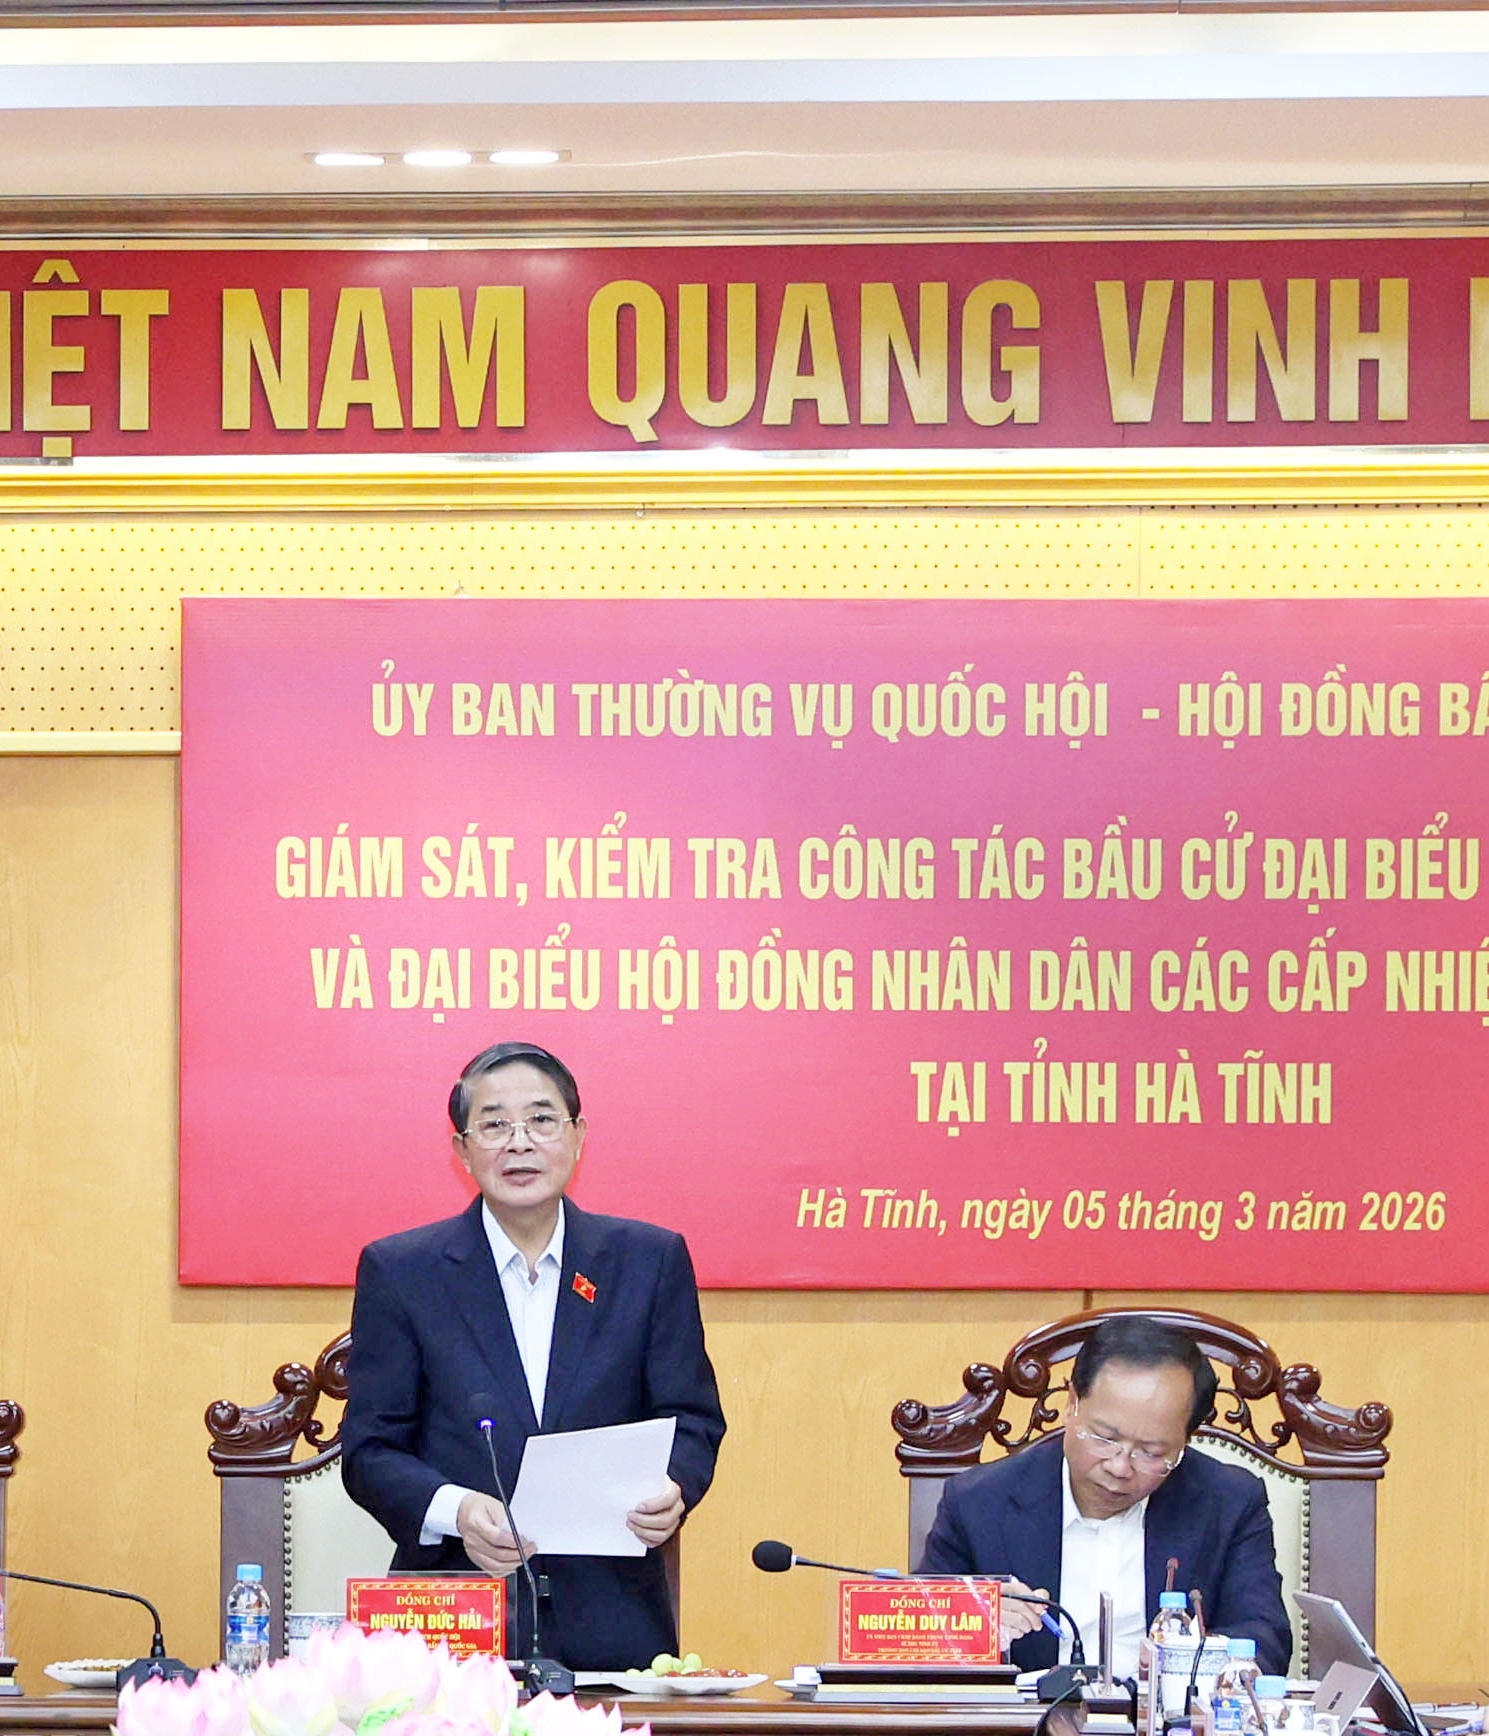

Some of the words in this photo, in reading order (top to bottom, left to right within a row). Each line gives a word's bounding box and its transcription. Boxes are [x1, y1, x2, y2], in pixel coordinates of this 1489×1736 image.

[220, 285, 526, 430] NAM
[586, 278, 1041, 443] QUANG
[1094, 277, 1410, 424] VINH
[371, 658, 435, 737] ỦY
[451, 682, 556, 737] BAN
[570, 668, 773, 738] THƯỜNG
[788, 683, 854, 750] VỤ
[871, 663, 1007, 744] QUỐC
[1024, 670, 1108, 749] HỘI
[1142, 708, 1160, 720] -
[1178, 670, 1262, 749] HỘI
[1278, 663, 1421, 737] ĐỒNG
[275, 822, 406, 900] GIÁM
[419, 821, 531, 909] SÁT,
[544, 810, 672, 900] KIỂM
[686, 837, 783, 900] TRA
[798, 823, 935, 901] CÔNG
[951, 823, 1045, 900] TÁC
[1063, 815, 1163, 901] BẦU
[1181, 810, 1254, 901] CỬ
[1262, 838, 1347, 914] ĐẠI
[1365, 811, 1480, 901] BIỂU
[309, 933, 375, 1010] VÀ
[387, 946, 475, 1024] ĐẠI
[488, 920, 603, 1012] BIỂU
[617, 934, 701, 1026] HỘI
[715, 927, 854, 1012] ĐỒNG
[871, 935, 1011, 1011] NHÂN
[1029, 936, 1132, 1012] DÂN
[1150, 936, 1249, 1013] CÁC
[1268, 927, 1368, 1013] CẤP
[909, 1061, 987, 1137] TẠI
[1003, 1037, 1117, 1123] TỈNH
[1135, 1048, 1202, 1124] HÀ
[1217, 1049, 1332, 1124] TĨNH
[796, 1186, 847, 1229] Hà
[860, 1188, 947, 1236] Tĩnh,
[960, 1188, 1053, 1240] ngày
[1063, 1189, 1106, 1230] 05
[1117, 1189, 1223, 1241] tháng
[1234, 1191, 1256, 1231] 3
[1267, 1192, 1347, 1231] năm
[1359, 1191, 1446, 1231] 2026
[370, 1608, 423, 1630] NGUYỄN
[427, 1609, 455, 1630] ĐỨC
[458, 1608, 482, 1630] HẢI
[434, 1592, 456, 1606] CHÍ
[858, 1609, 916, 1631] NGUYỄN
[919, 1614, 948, 1631] DUY
[951, 1612, 983, 1631] LÂM
[928, 1596, 951, 1609] CHÍ
